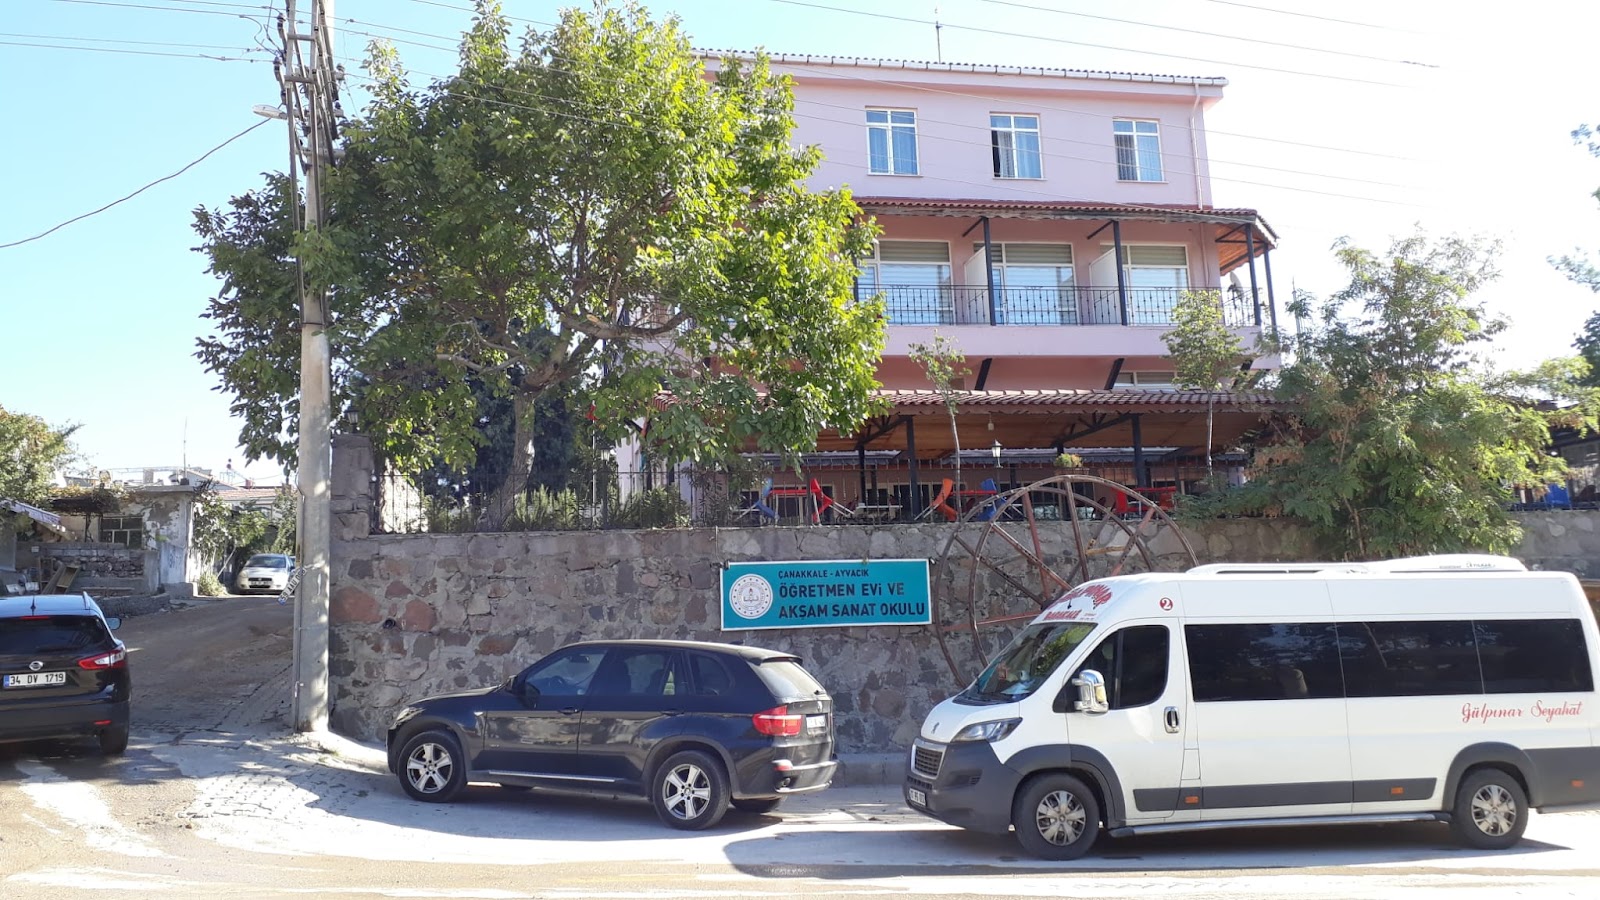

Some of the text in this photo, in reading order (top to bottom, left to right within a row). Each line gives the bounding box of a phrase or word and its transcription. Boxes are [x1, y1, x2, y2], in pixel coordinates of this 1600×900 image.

[778, 570, 828, 579] ÇANAKKALE
[779, 582, 855, 598] ÖĞRETMEN
[888, 582, 904, 596] VE
[778, 602, 925, 620] AKŞAM SANAT OKULU
[1161, 598, 1172, 610] 2
[10, 673, 64, 685] 34 DV 1719
[1530, 700, 1582, 722] Seyahat
